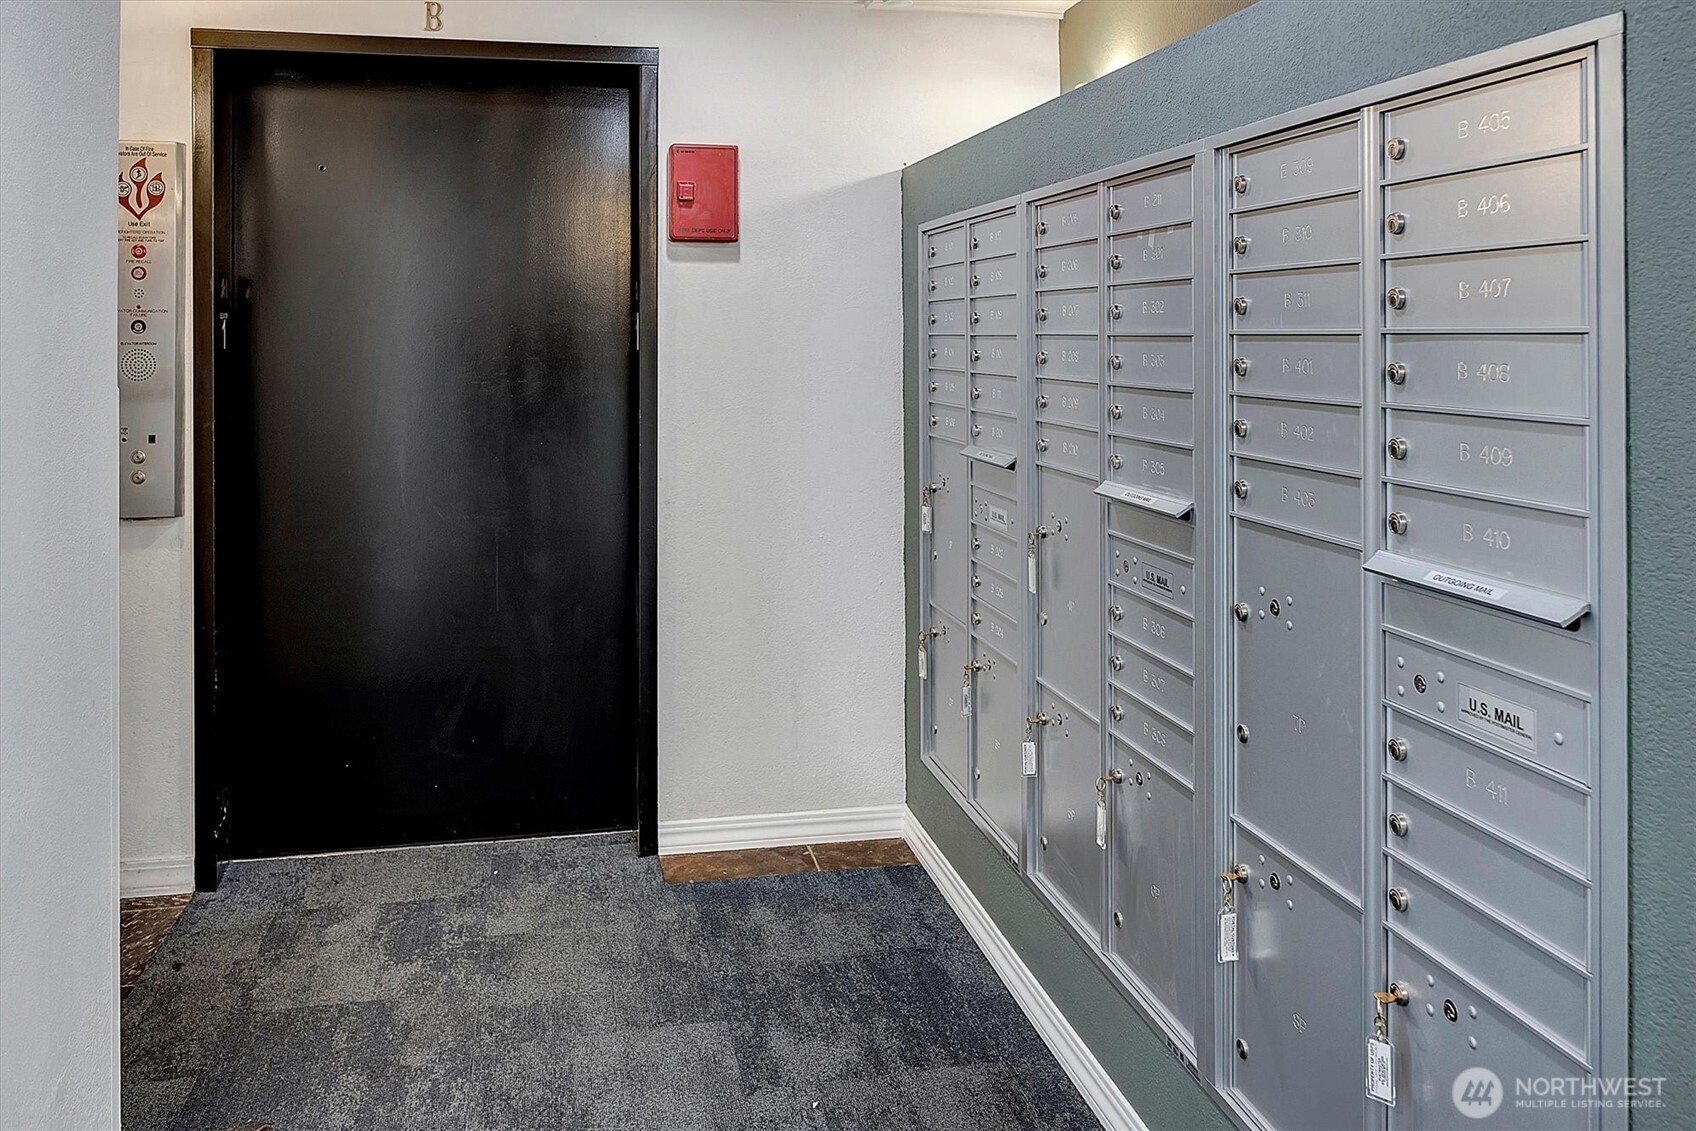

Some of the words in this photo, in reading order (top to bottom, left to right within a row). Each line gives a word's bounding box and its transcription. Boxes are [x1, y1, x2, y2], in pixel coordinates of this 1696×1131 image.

[424, 2, 443, 32] B
[1458, 120, 1469, 139] B
[1478, 110, 1511, 134] 405
[1458, 200, 1468, 219] B
[1477, 194, 1511, 215] 406
[1458, 282, 1470, 300] B
[1478, 278, 1512, 298] 407
[1297, 292, 1311, 308] 311
[1295, 358, 1314, 376] 401
[1458, 361, 1468, 380] B
[1293, 425, 1314, 442] 402
[1460, 443, 1470, 462] B
[1480, 446, 1513, 467] 409
[1463, 524, 1474, 543] B
[1483, 527, 1511, 550] 410
[1156, 575, 1170, 588] MAIL
[1432, 574, 1475, 590] OUTGOING
[1474, 585, 1494, 595] MAIL
[1151, 620, 1165, 639] 306
[1151, 674, 1166, 692] 307
[1469, 698, 1492, 718] U.S.
[1494, 708, 1524, 732] MAIL
[1466, 768, 1477, 788] B
[1485, 780, 1509, 806] 411
